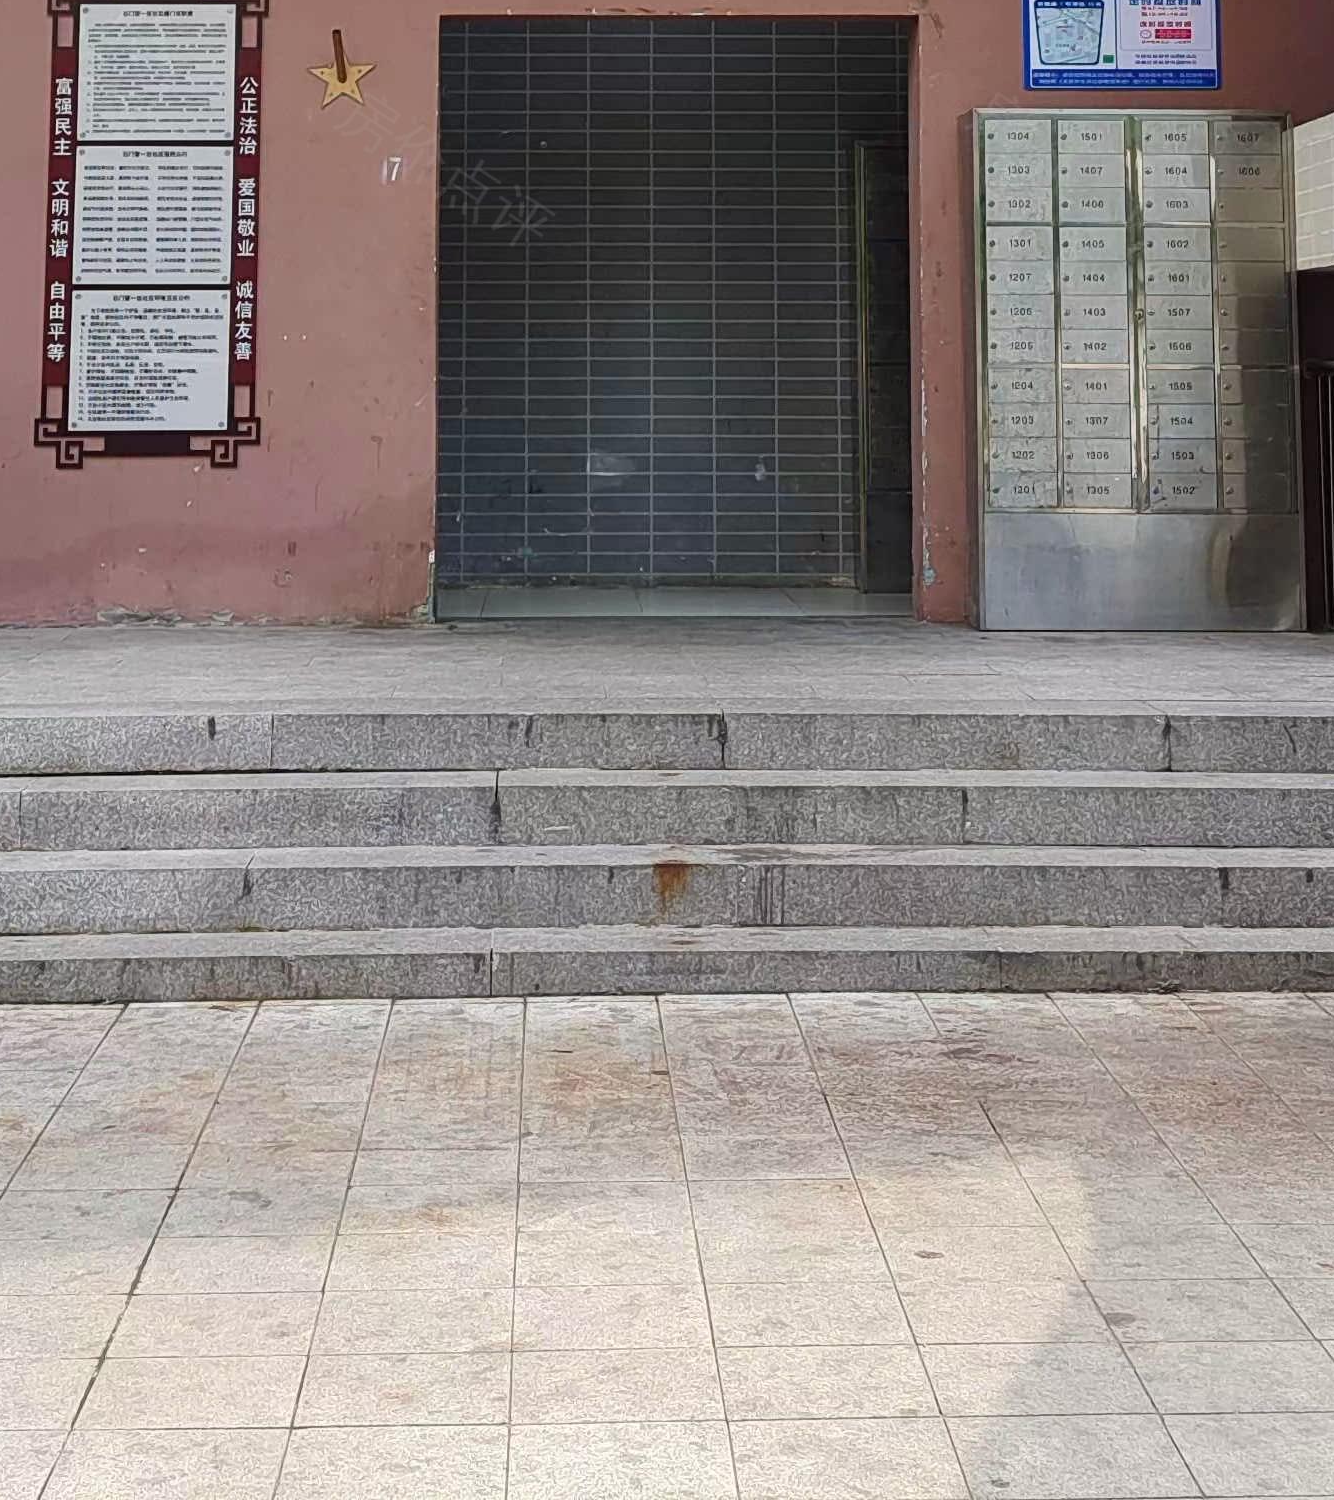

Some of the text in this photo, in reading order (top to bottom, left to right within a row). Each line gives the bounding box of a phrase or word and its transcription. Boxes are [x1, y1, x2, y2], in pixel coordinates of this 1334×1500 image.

[53, 77, 74, 156] 富强民主
[239, 76, 258, 155] 公正法治
[1007, 132, 1030, 141] 1304
[1080, 133, 1102, 141] 1501
[1164, 133, 1187, 142] 1605
[1237, 133, 1260, 142] 1607
[1007, 166, 1030, 174] 1303
[1080, 167, 1103, 175] 1407
[1165, 167, 1188, 175] 1604
[1165, 201, 1189, 209] 1603
[49, 178, 69, 257] 文明和谐
[237, 178, 256, 257] 爱国敬业
[1009, 239, 1032, 248] 1301
[1081, 239, 1105, 248] 1405
[1166, 240, 1189, 248] 1602
[1009, 274, 1033, 282] 1207
[1082, 274, 1105, 282] 1404
[1168, 274, 1190, 282] 1601
[1083, 308, 1106, 317] 1403
[1167, 308, 1191, 317] 1507
[47, 281, 66, 362] 自由平等
[234, 281, 254, 361] 诚信友善
[1083, 342, 1107, 351] 1402
[1085, 382, 1108, 390] 1401
[1011, 416, 1034, 425] 1203
[1085, 416, 1109, 425] 1307
[1170, 417, 1193, 426] 1504
[1012, 451, 1035, 460] 1202
[1171, 451, 1194, 460] 1503
[1171, 486, 1195, 495] 1502
